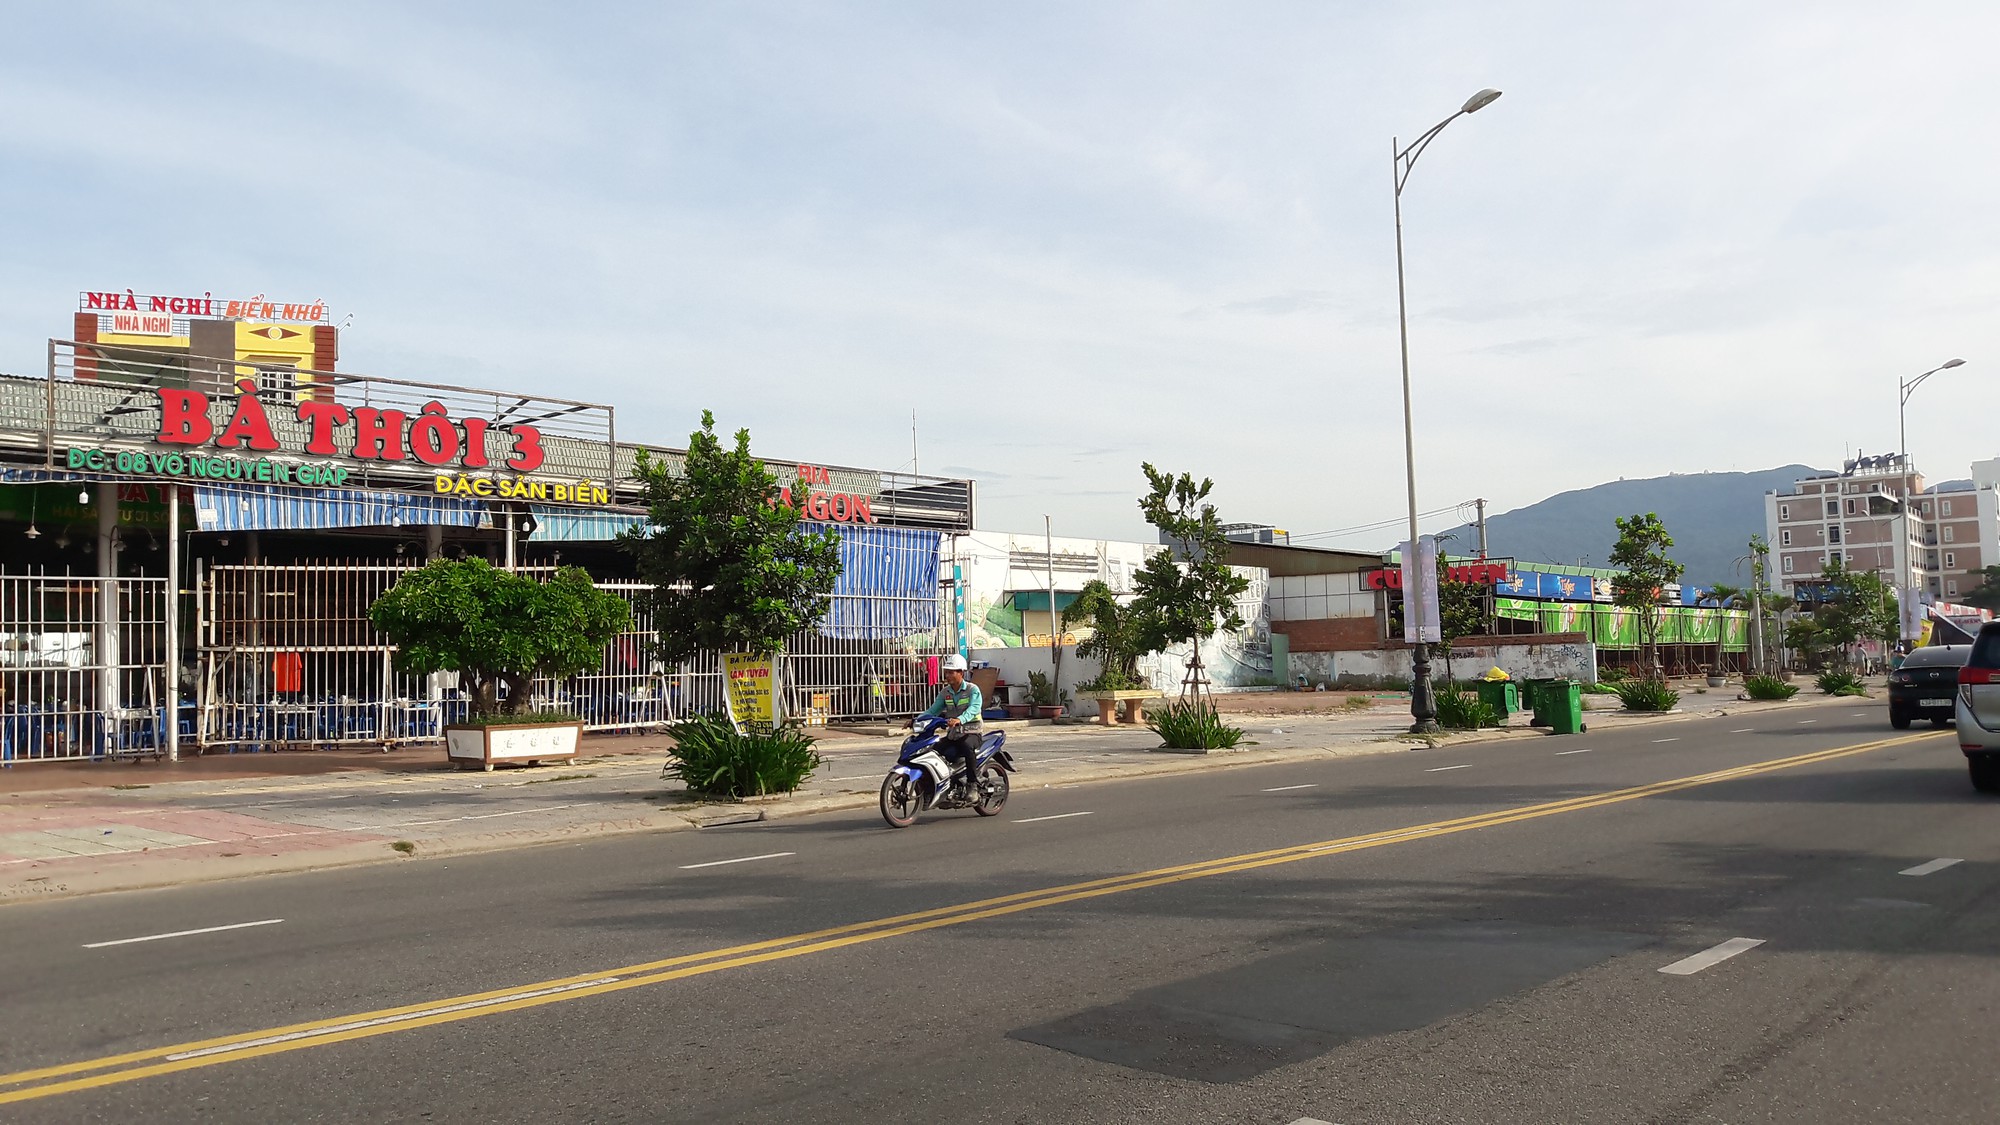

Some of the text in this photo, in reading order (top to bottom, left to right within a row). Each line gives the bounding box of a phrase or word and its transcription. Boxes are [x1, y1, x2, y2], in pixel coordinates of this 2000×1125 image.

[86, 288, 212, 316] NHÀ NGHỈ
[224, 294, 275, 318] BIỂN
[115, 312, 171, 333] NHÀ NGHỈ
[155, 378, 545, 472] BÀ THÔI 3
[67, 448, 112, 472] ĐC:
[116, 451, 149, 474] 08
[152, 451, 186, 476] VÕ
[296, 463, 349, 486] GIÁP
[797, 464, 831, 485] BIA
[435, 473, 608, 504] ĐẶC SẢN BIỂN
